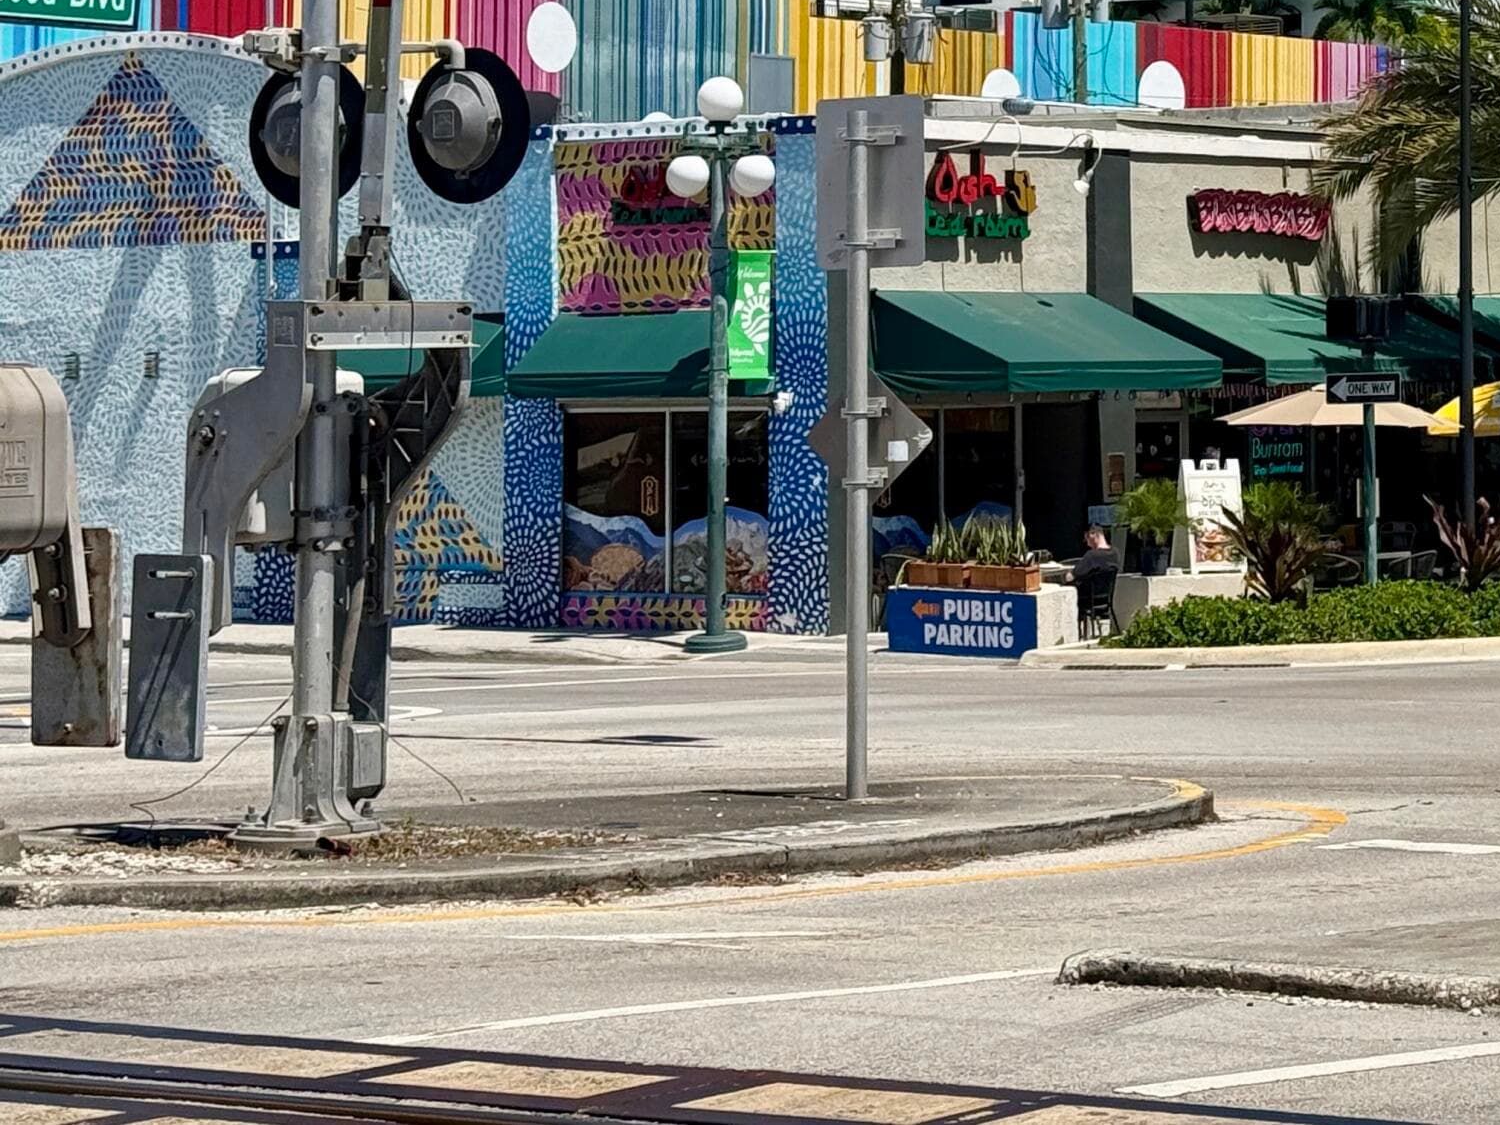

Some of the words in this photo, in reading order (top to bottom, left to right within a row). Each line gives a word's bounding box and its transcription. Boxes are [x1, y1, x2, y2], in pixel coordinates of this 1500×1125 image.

[1348, 383, 1368, 395] ONE
[1371, 382, 1392, 394] WAY
[943, 599, 1014, 624] PUBLIC
[924, 623, 1015, 649] PARKING
